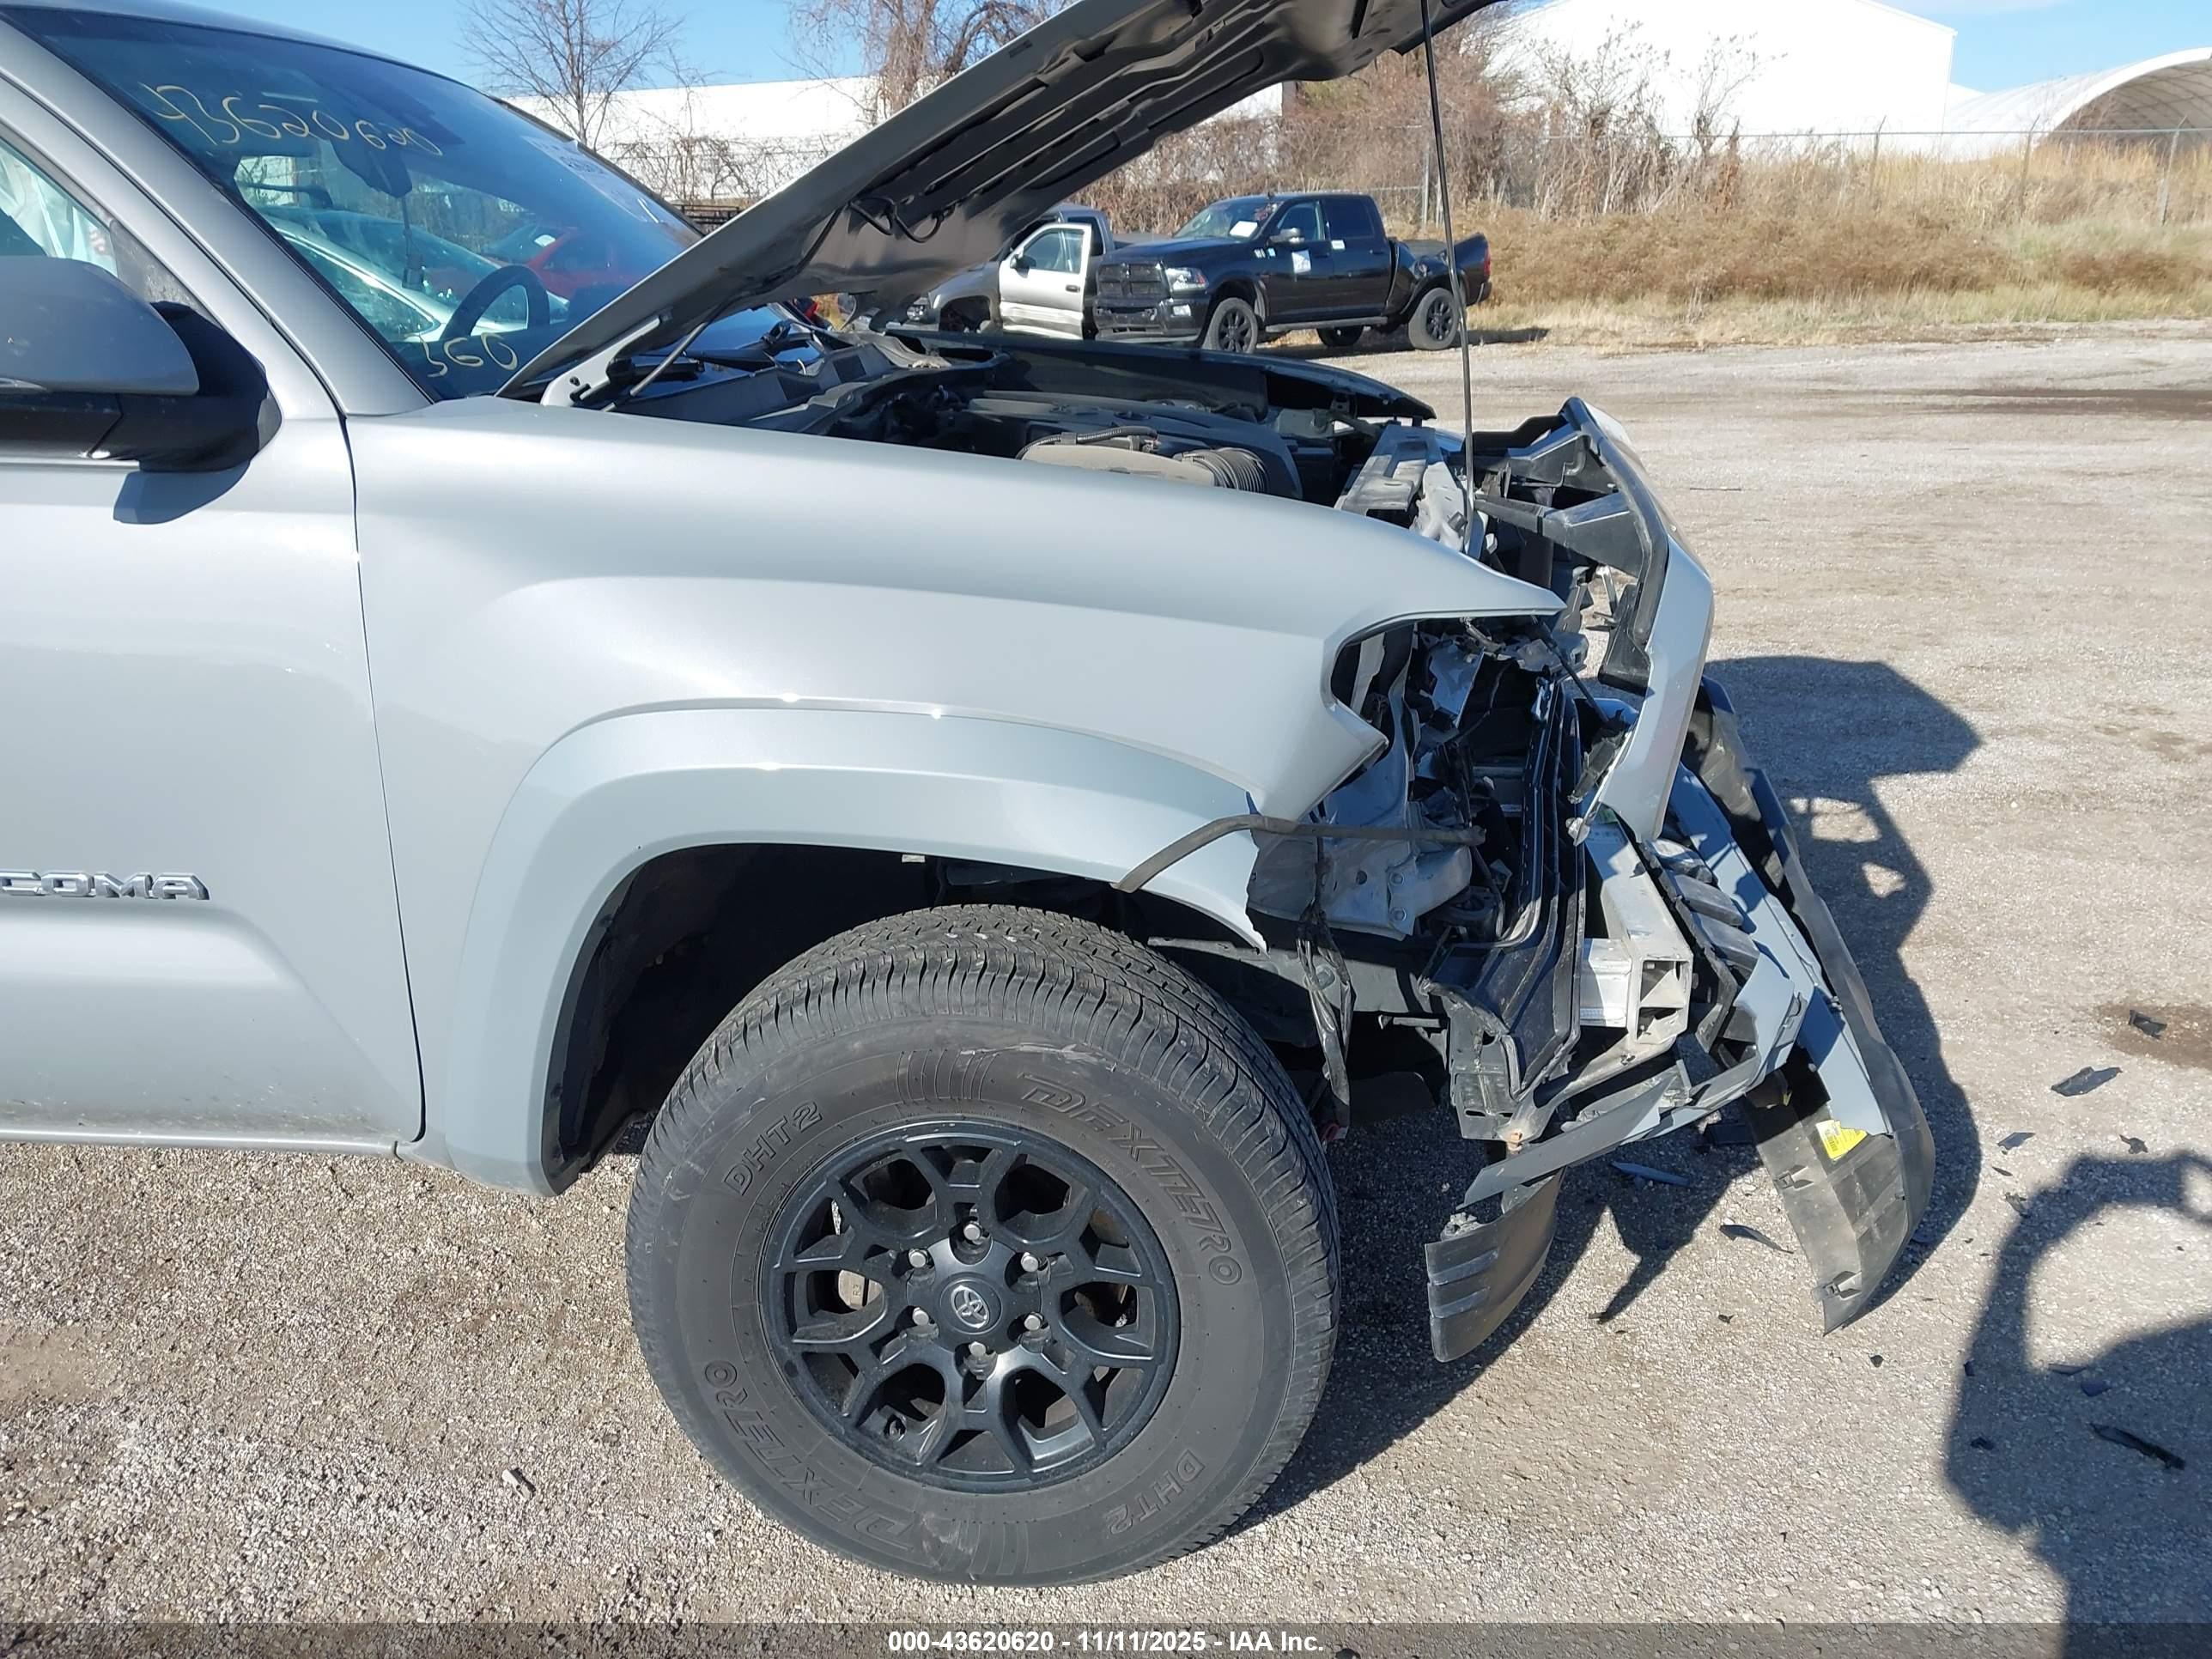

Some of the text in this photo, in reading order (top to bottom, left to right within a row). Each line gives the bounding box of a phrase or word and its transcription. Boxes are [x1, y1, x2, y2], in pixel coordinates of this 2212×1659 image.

[723, 1100, 823, 1197] DHT2
[1017, 1072, 1243, 1286] DEXTERO
[704, 1359, 914, 1551] DEXTERO
[1105, 1449, 1206, 1536] DHT2
